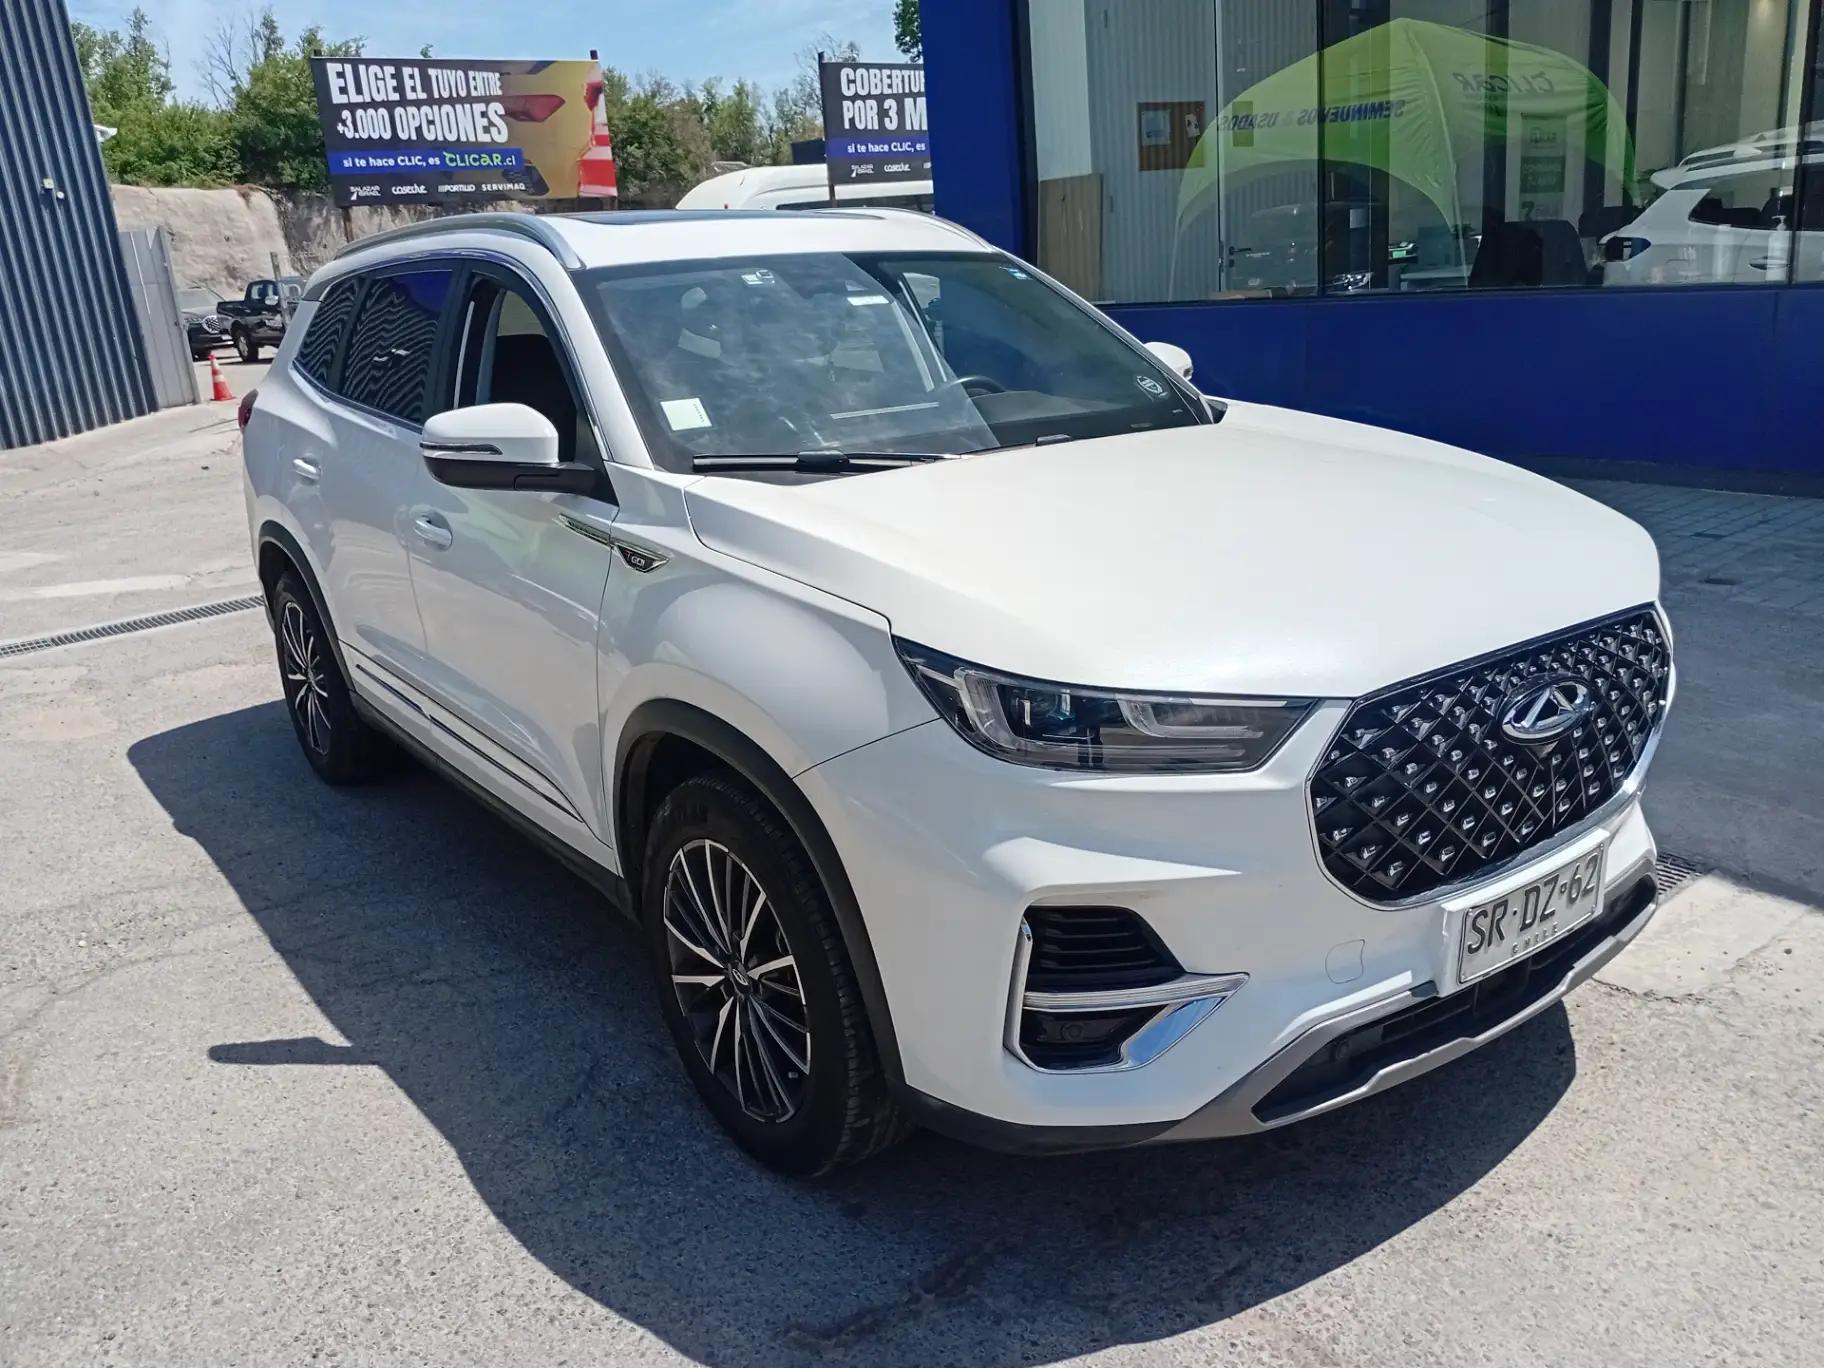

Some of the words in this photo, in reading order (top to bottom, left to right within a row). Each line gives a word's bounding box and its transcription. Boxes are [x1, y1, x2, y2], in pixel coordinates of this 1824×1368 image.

[327, 62, 400, 104] ELIGE
[402, 66, 427, 100] EL
[428, 68, 467, 99] TUYO
[467, 70, 503, 97] ENTRE
[336, 107, 392, 140] +3.000
[394, 102, 509, 143] OPCIONES
[842, 99, 879, 130] POR
[883, 98, 899, 131] 3
[847, 143, 855, 153] si
[857, 143, 867, 153] te
[868, 142, 889, 153] hace
[915, 142, 926, 151] es
[343, 157, 353, 168] si
[355, 157, 367, 167] te
[369, 156, 395, 167] hace
[428, 157, 440, 166] es
[481, 182, 527, 192] SERVIMAQ
